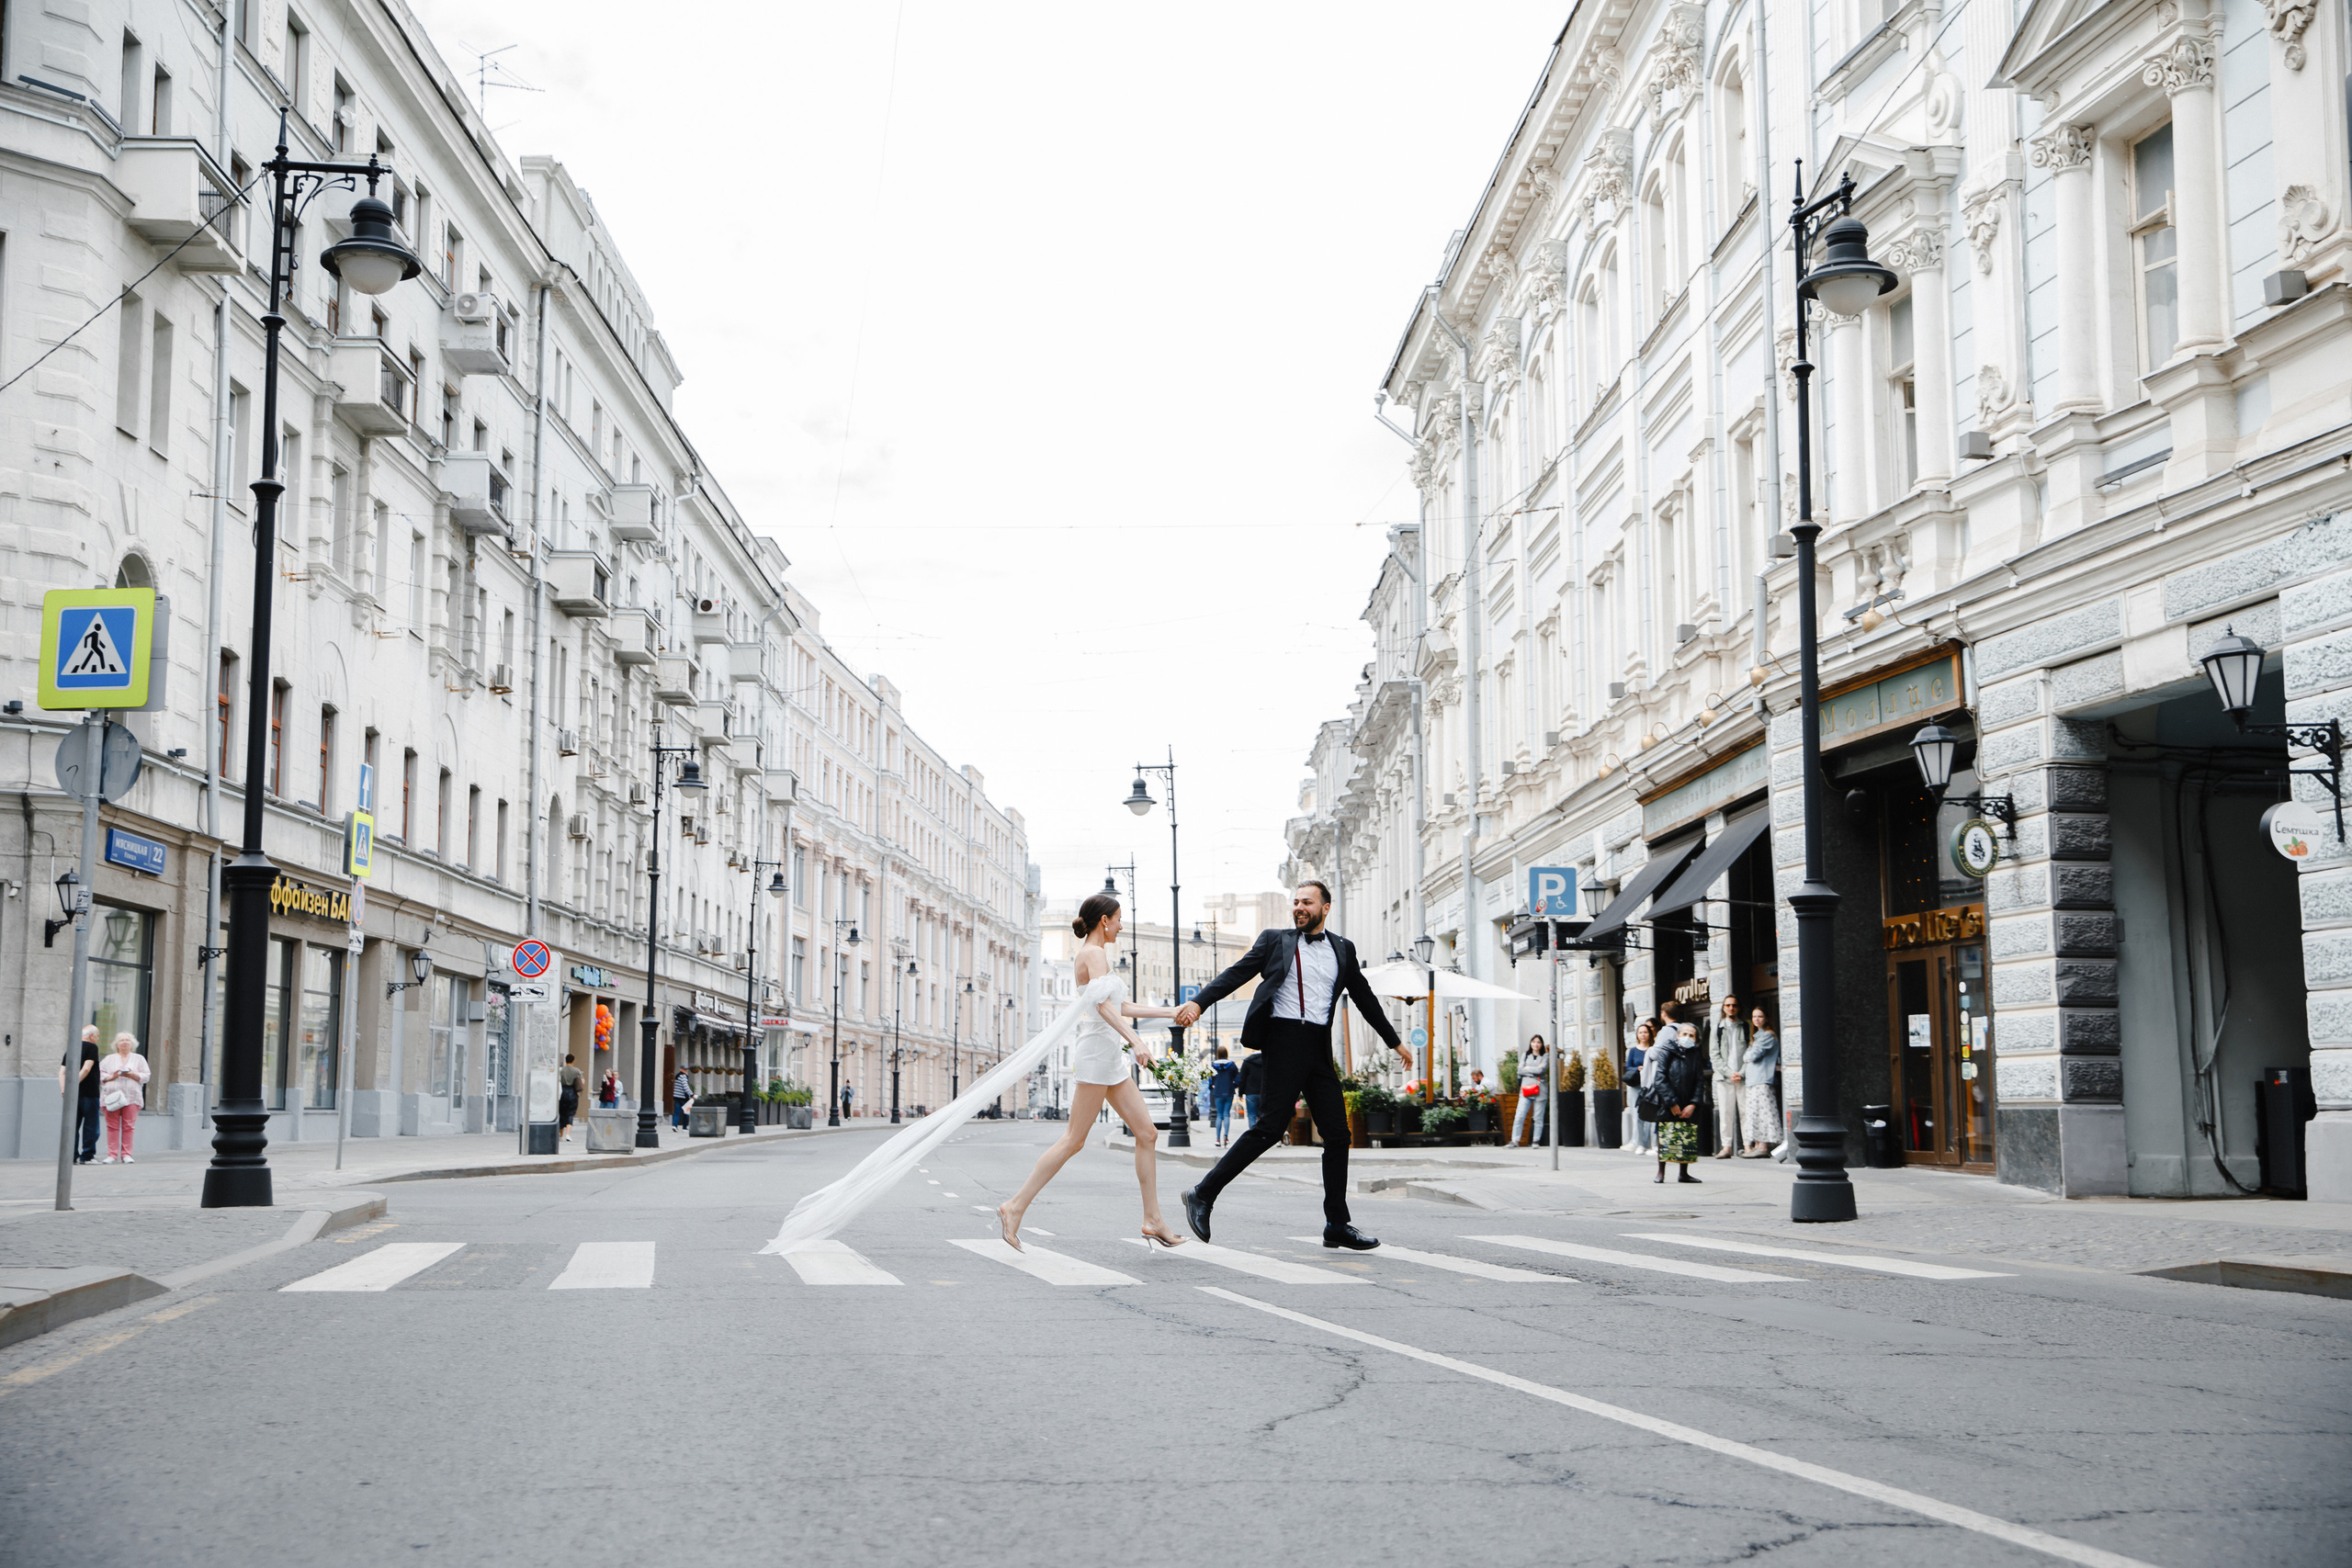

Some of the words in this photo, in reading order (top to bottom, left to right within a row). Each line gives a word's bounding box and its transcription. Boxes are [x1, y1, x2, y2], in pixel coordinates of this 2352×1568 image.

[2276, 820, 2319, 836] Семушка
[115, 837, 148, 856] МЯСНИЦКАЯ
[153, 846, 164, 863] 22
[270, 875, 329, 917] ффайзен
[331, 891, 351, 921] БА
[1538, 873, 1566, 906] P
[1185, 987, 1197, 1004] P
